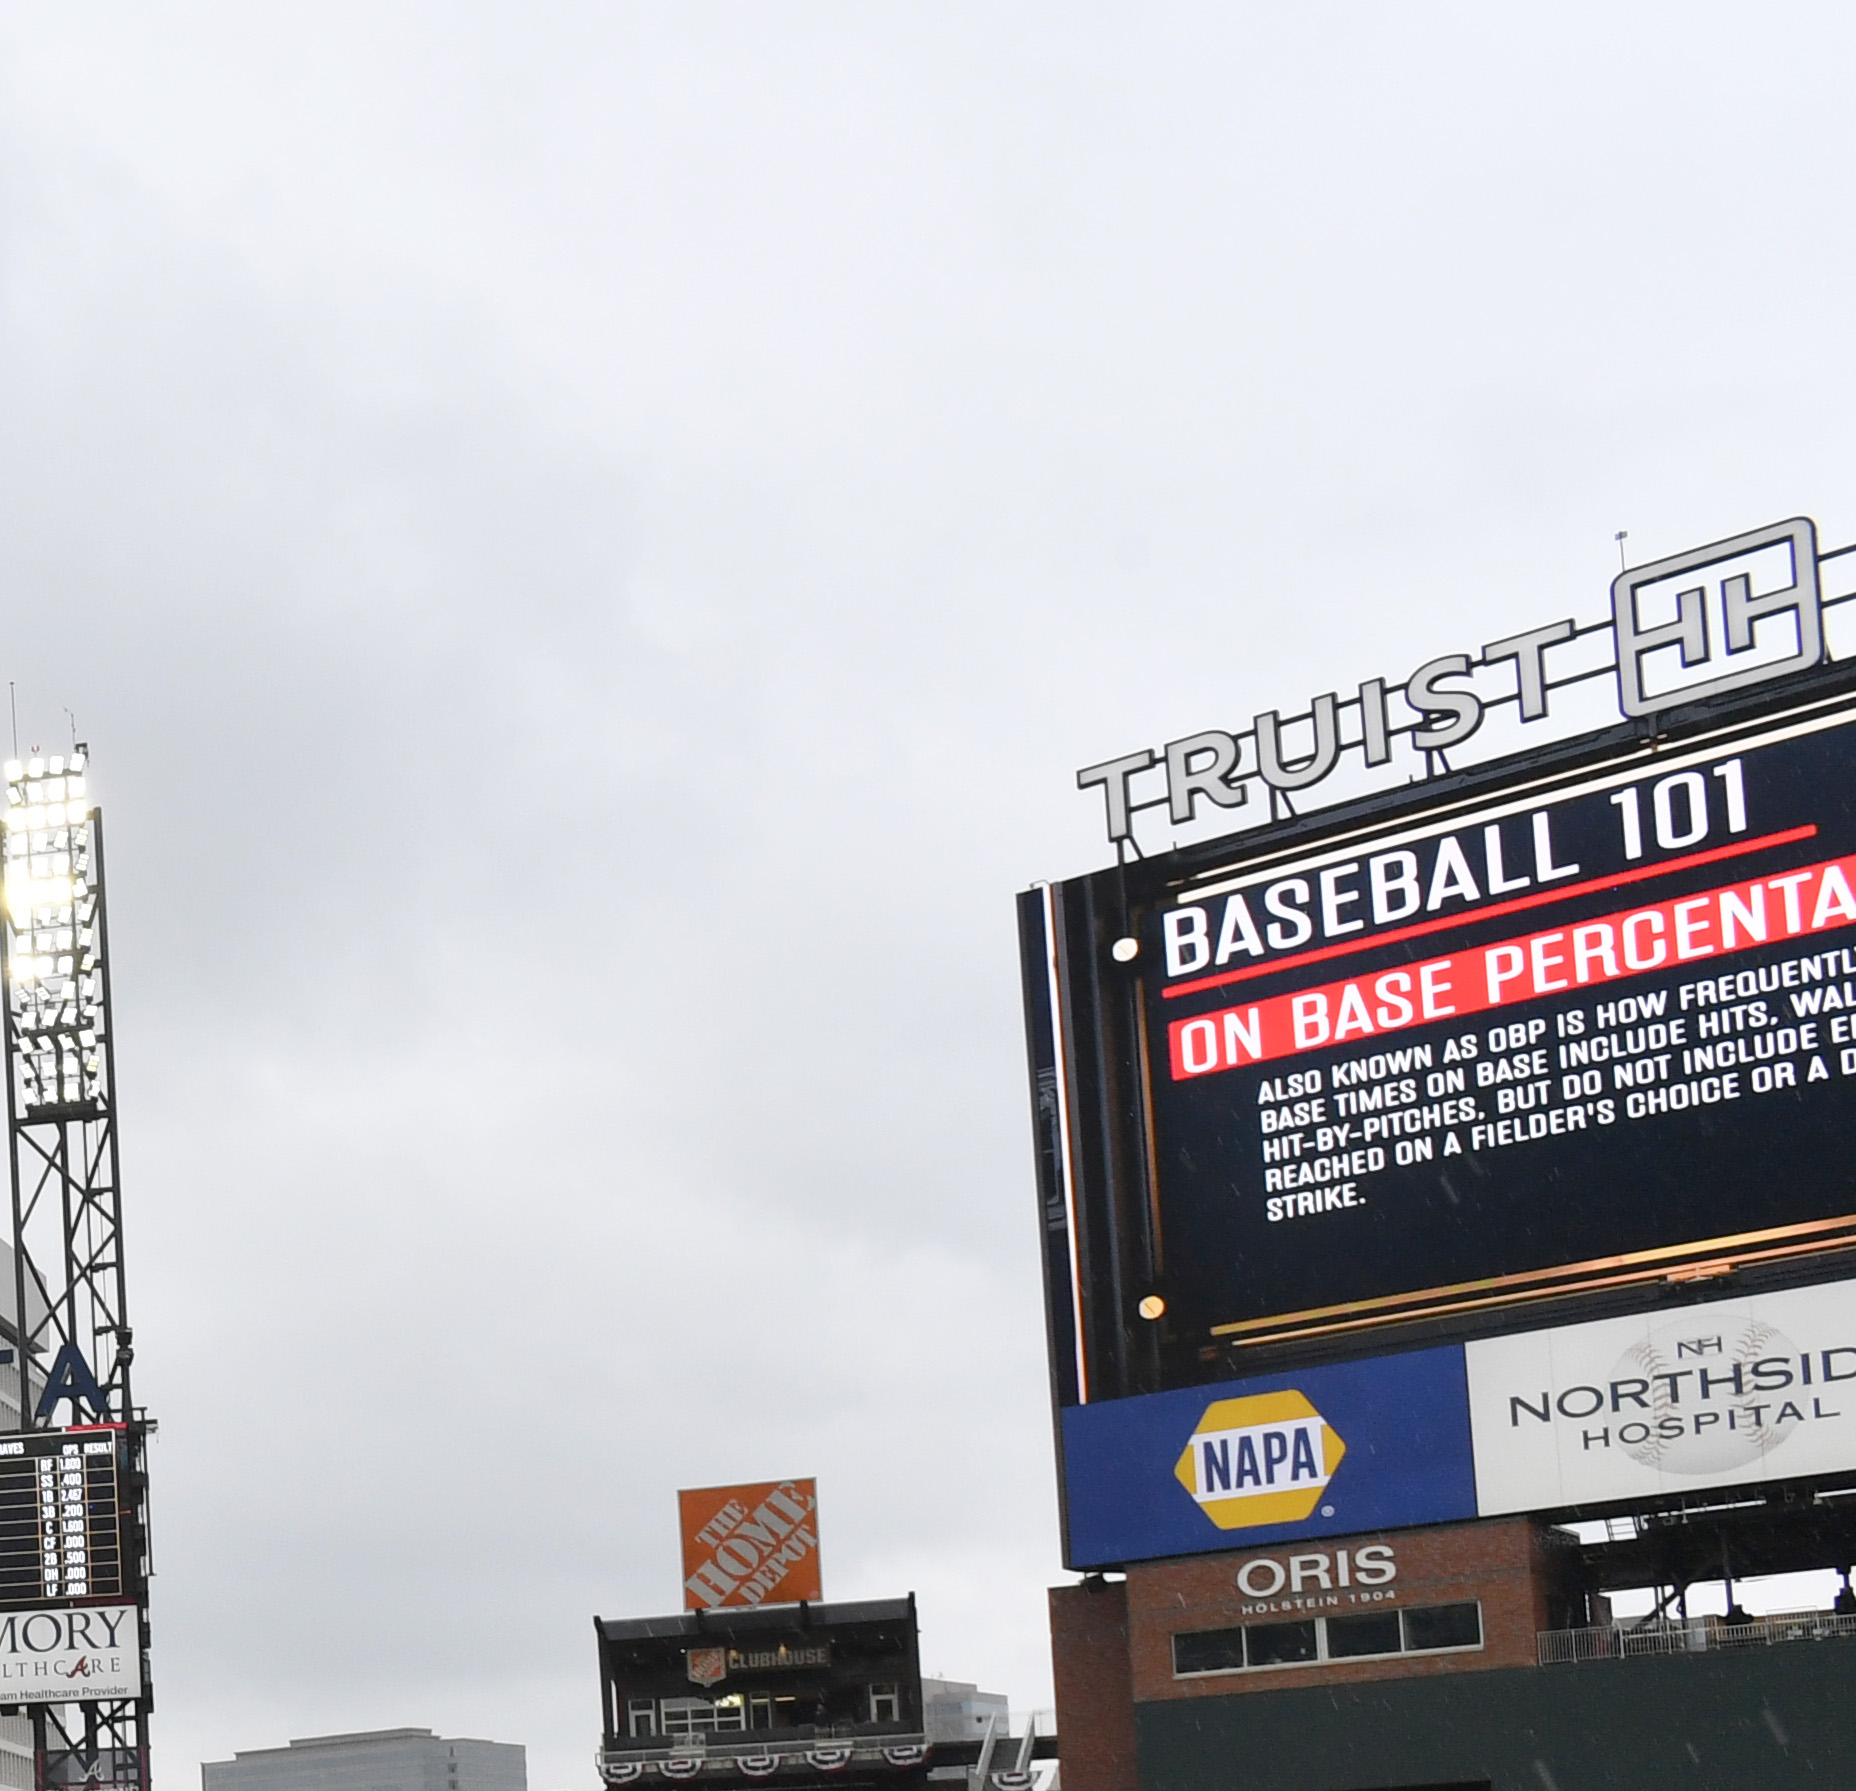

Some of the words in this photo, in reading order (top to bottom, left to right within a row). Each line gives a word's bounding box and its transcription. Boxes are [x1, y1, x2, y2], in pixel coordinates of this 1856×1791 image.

[1078, 618, 1575, 842] TRUIST
[1161, 811, 1579, 977] BASEBALL
[1610, 758, 1747, 860] 101
[1181, 1007, 1262, 1074] ON
[1292, 961, 1455, 1049] BASE
[1486, 865, 1856, 1004] PERCENTA
[1258, 1069, 1322, 1105] ALSO
[1332, 1044, 1433, 1088] KNOWN
[1443, 1034, 1478, 1063] AS
[1488, 1018, 1546, 1052] OBP
[1557, 1010, 1585, 1037] IS
[1597, 990, 1667, 1029] HOW
[1679, 946, 1856, 1011] FREQUENTL
[1260, 1098, 1326, 1133] BASE
[1333, 1079, 1417, 1117] TIMES
[1427, 1068, 1466, 1098] ON
[1476, 1049, 1549, 1087] BASE
[1559, 1018, 1687, 1069] INCLUDE
[1699, 1001, 1778, 1038] HITS,
[1262, 1097, 1485, 1163] HIT-BY-PITCHES,
[1497, 1080, 1551, 1114] BUT
[1562, 1070, 1602, 1100] DO
[1614, 1054, 1672, 1089] NOT
[1683, 1023, 1818, 1075] INCLUDE
[1830, 1014, 1856, 1044] E
[1265, 1147, 1385, 1192] REACHED
[1395, 1136, 1433, 1165] ON
[1443, 1131, 1462, 1156] A
[1472, 1099, 1615, 1150] FIELDER'S
[1626, 1072, 1740, 1119] CHOICE
[1751, 1061, 1797, 1093] OR
[1807, 1055, 1829, 1082] A
[1266, 1182, 1366, 1222] STRIKE.
[1510, 1347, 1856, 1427] NORTHSID
[1582, 1397, 1841, 1450] HOSPITAL
[1203, 1426, 1319, 1493] NAPA
[685, 1480, 815, 1608] HOME
[694, 1499, 749, 1548] THE
[738, 1524, 818, 1604] DEPOT
[1237, 1545, 1396, 1598] ORIS
[1241, 1595, 1338, 1616] HOLSTEIN
[1349, 1590, 1396, 1604] 1904
[20, 1687, 80, 1700] Healthcare
[82, 1685, 129, 1697] Provider
[728, 1648, 827, 1669] CLUBHOUSE
